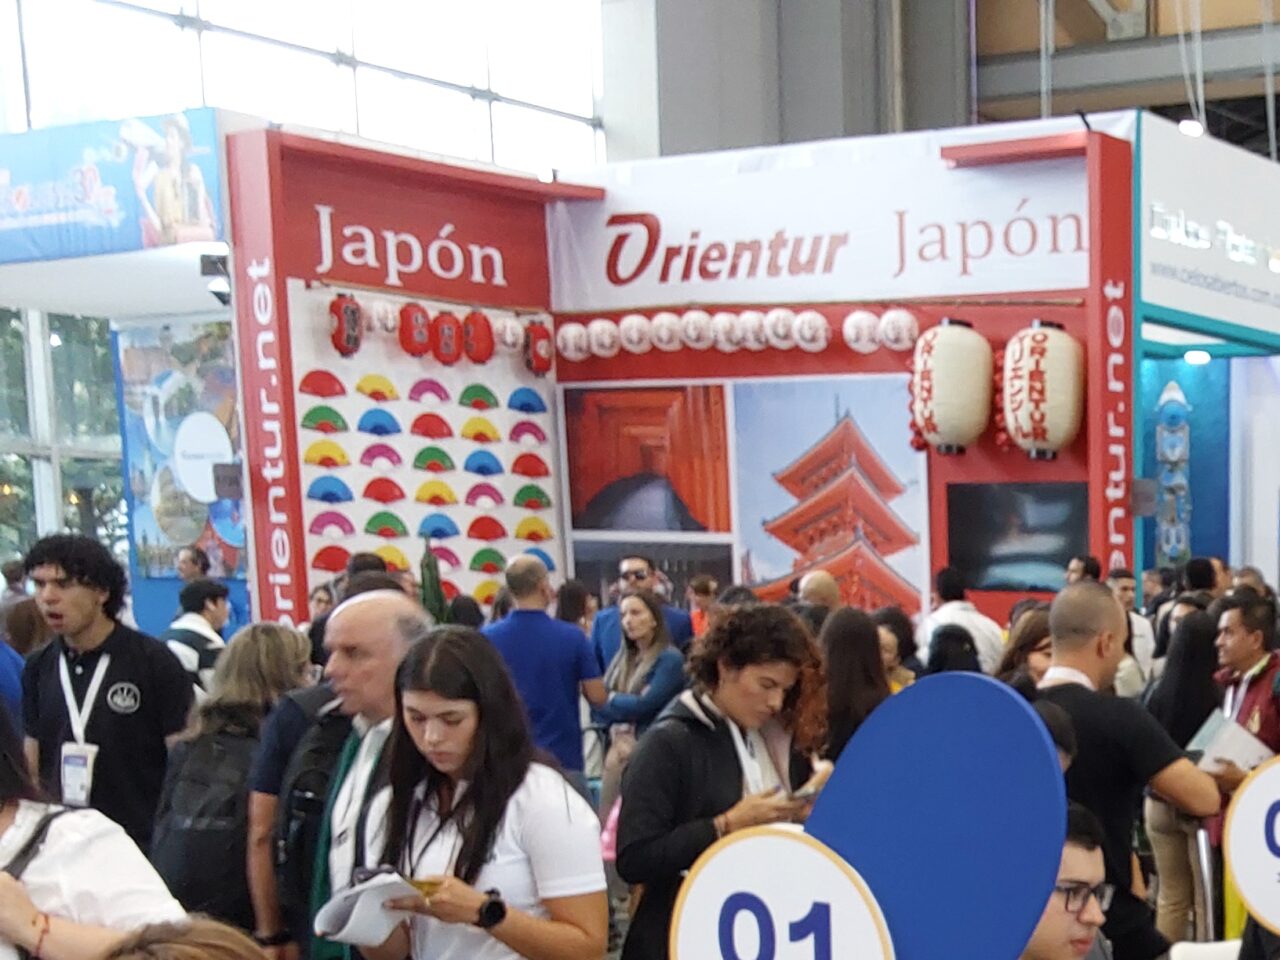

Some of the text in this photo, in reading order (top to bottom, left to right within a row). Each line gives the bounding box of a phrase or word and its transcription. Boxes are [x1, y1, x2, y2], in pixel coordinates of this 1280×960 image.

[314, 203, 507, 287] Japón
[605, 212, 849, 287] Orientur
[892, 198, 1089, 277] Japón
[1103, 280, 1126, 570] entur.net
